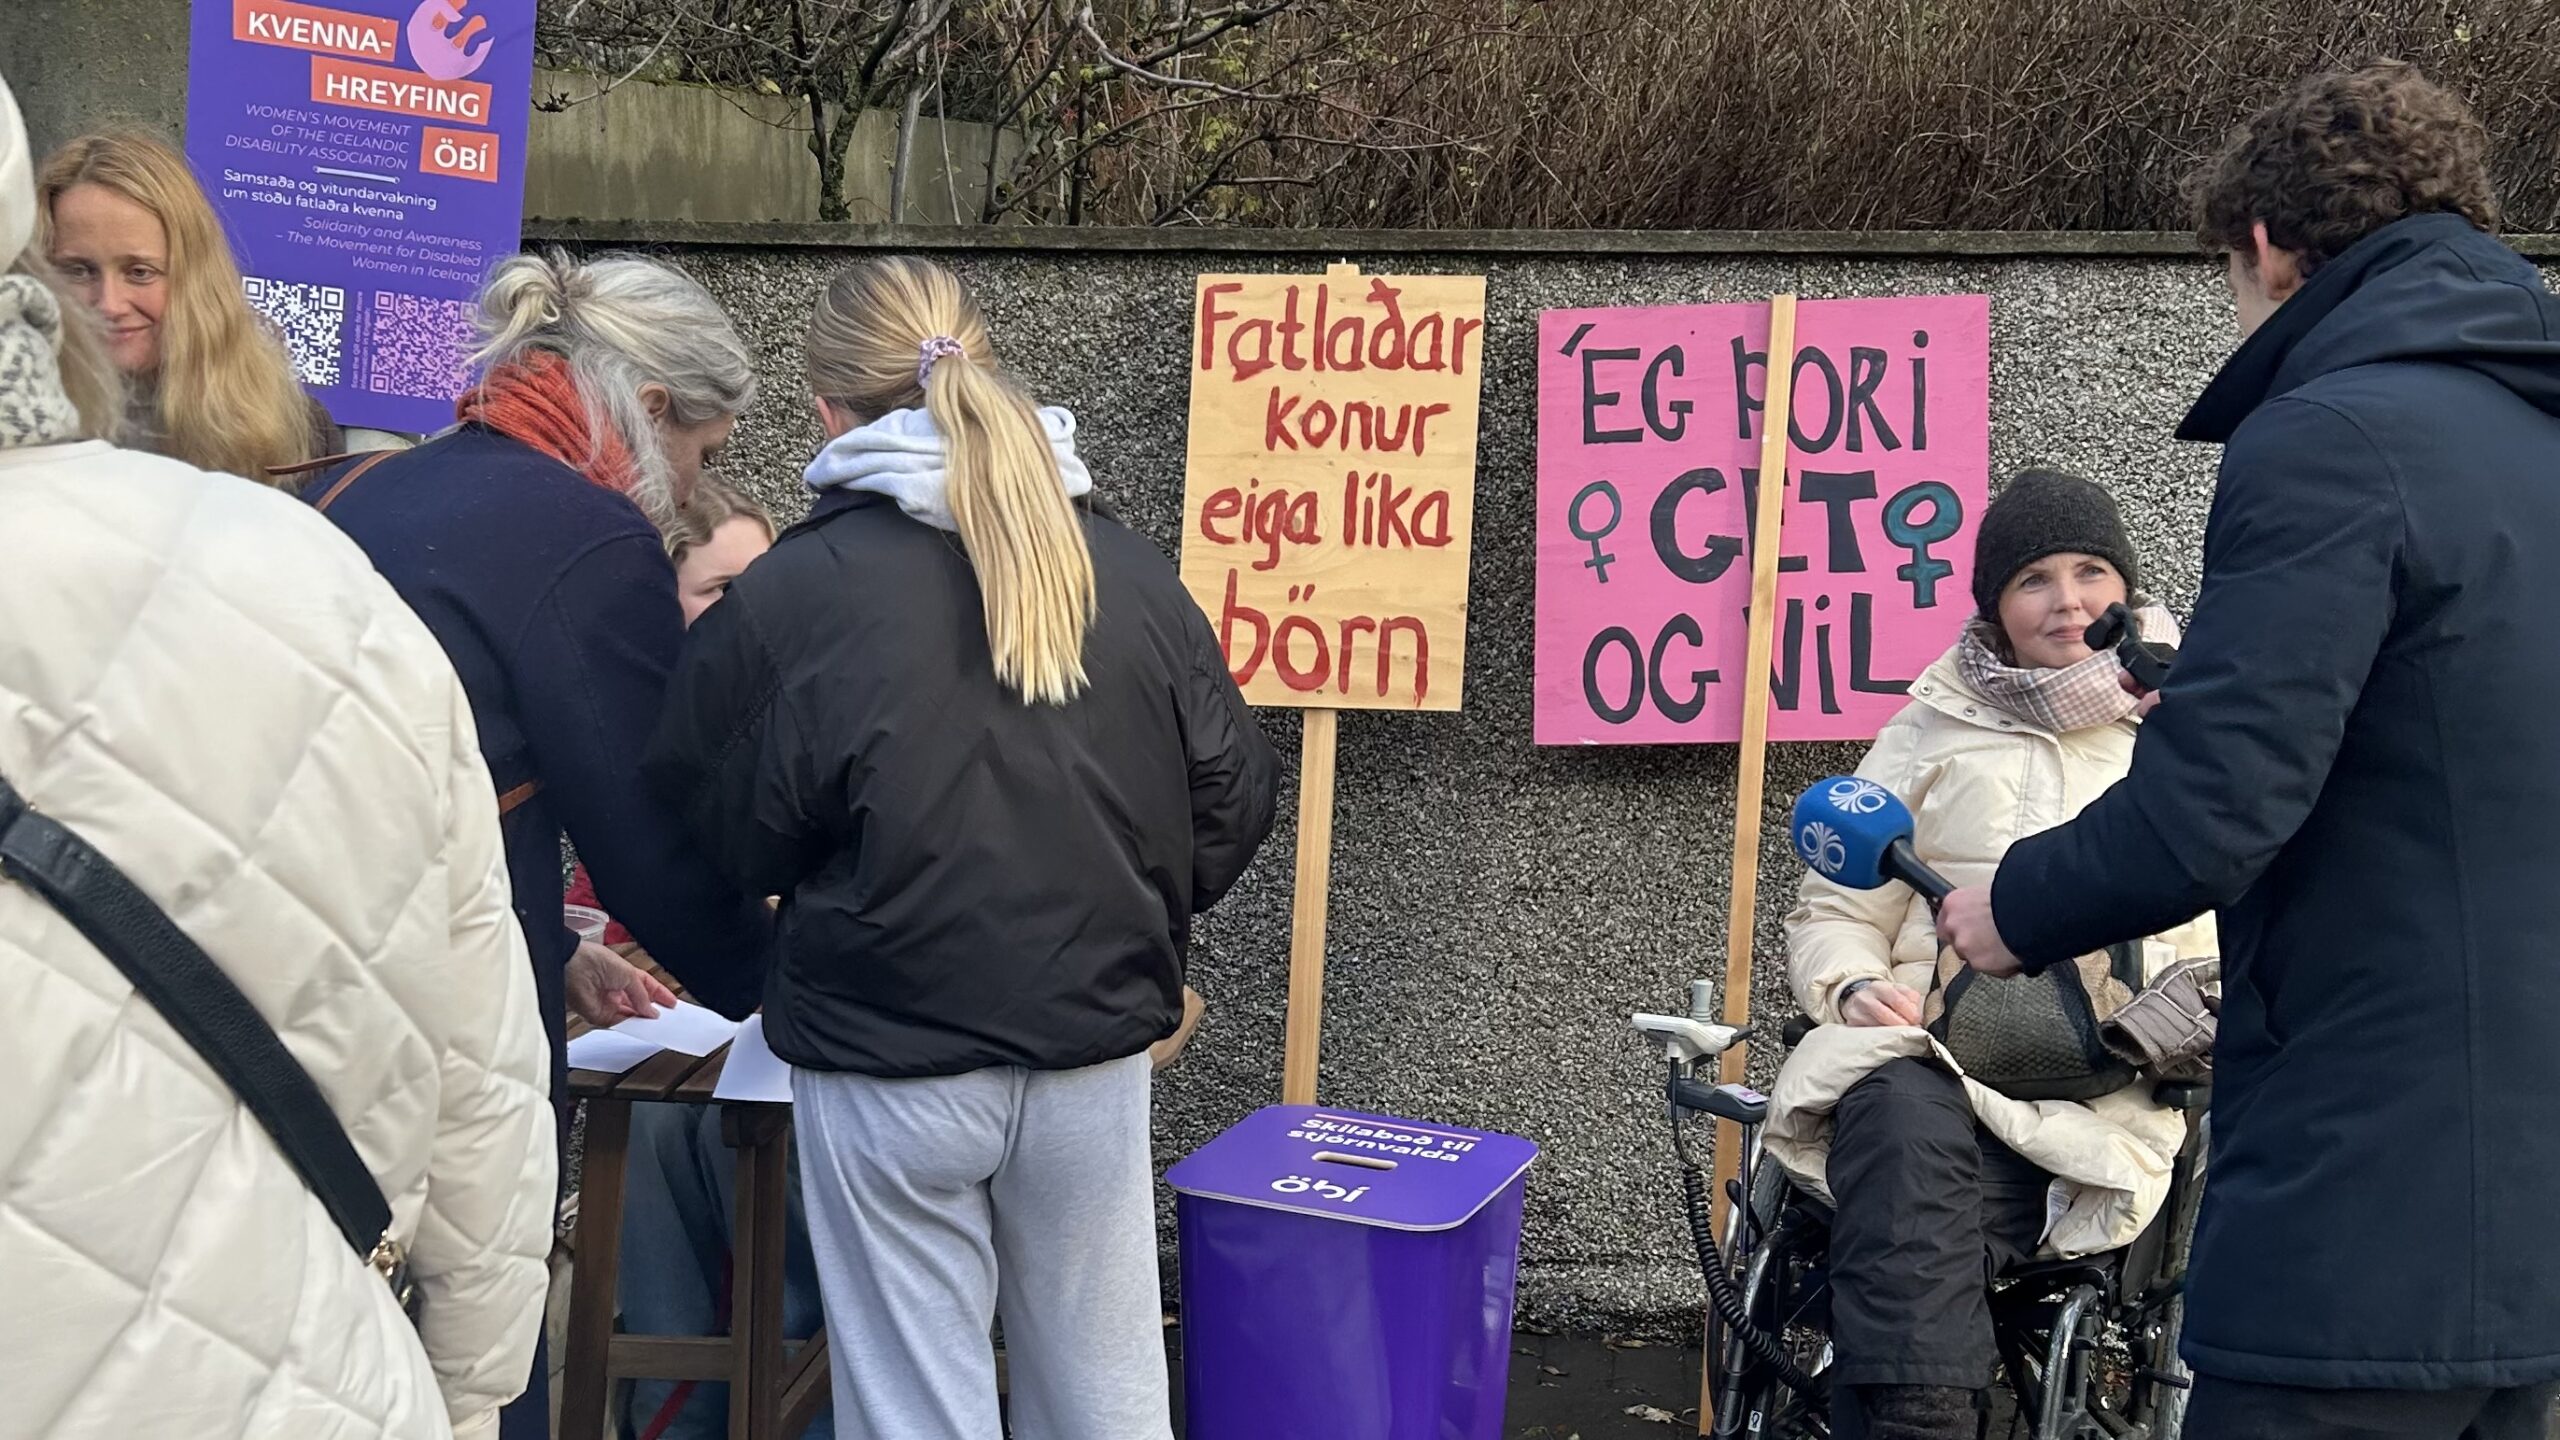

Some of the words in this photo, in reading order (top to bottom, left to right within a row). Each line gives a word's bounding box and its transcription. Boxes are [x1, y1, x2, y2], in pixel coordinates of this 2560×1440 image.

[248, 11, 393, 54] KVENNA-
[325, 73, 481, 118] HREYFING
[245, 104, 321, 125] WOMEN'S
[323, 114, 412, 137] MOVEMENT
[225, 134, 307, 156] DISABILITY
[307, 146, 409, 170] ASSOCIATION
[271, 124, 295, 137] OF
[297, 127, 326, 143] THE
[328, 132, 410, 154] ICELANDIC
[433, 137, 489, 173] ÖBÍ
[223, 168, 295, 189] Samstaða
[298, 180, 318, 195] og
[320, 182, 438, 211] vitundarvakning
[223, 188, 248, 199] um
[251, 190, 292, 206] stöðu
[295, 194, 349, 213] fatlaðra
[352, 202, 404, 221] kvenna
[287, 230, 313, 245] The
[316, 235, 393, 255] Movement
[395, 244, 419, 258] for
[418, 248, 481, 267] Disabled
[302, 216, 371, 238] Solidarity
[373, 226, 402, 240] and
[404, 230, 482, 251] Awareness
[352, 255, 408, 274] Women
[411, 262, 424, 276] in
[427, 266, 481, 284] Iceland
[1201, 278, 1482, 382] Fatlaðar
[1265, 386, 1451, 456] konur
[1200, 478, 1323, 571] eiga
[1342, 470, 1454, 548] líka
[1219, 568, 1429, 707] börn
[1582, 612, 1721, 724] OG
[1286, 1127, 1461, 1163] stjórnvalda
[1300, 1119, 1435, 1146] Skilaboð
[1440, 1137, 1477, 1153] til
